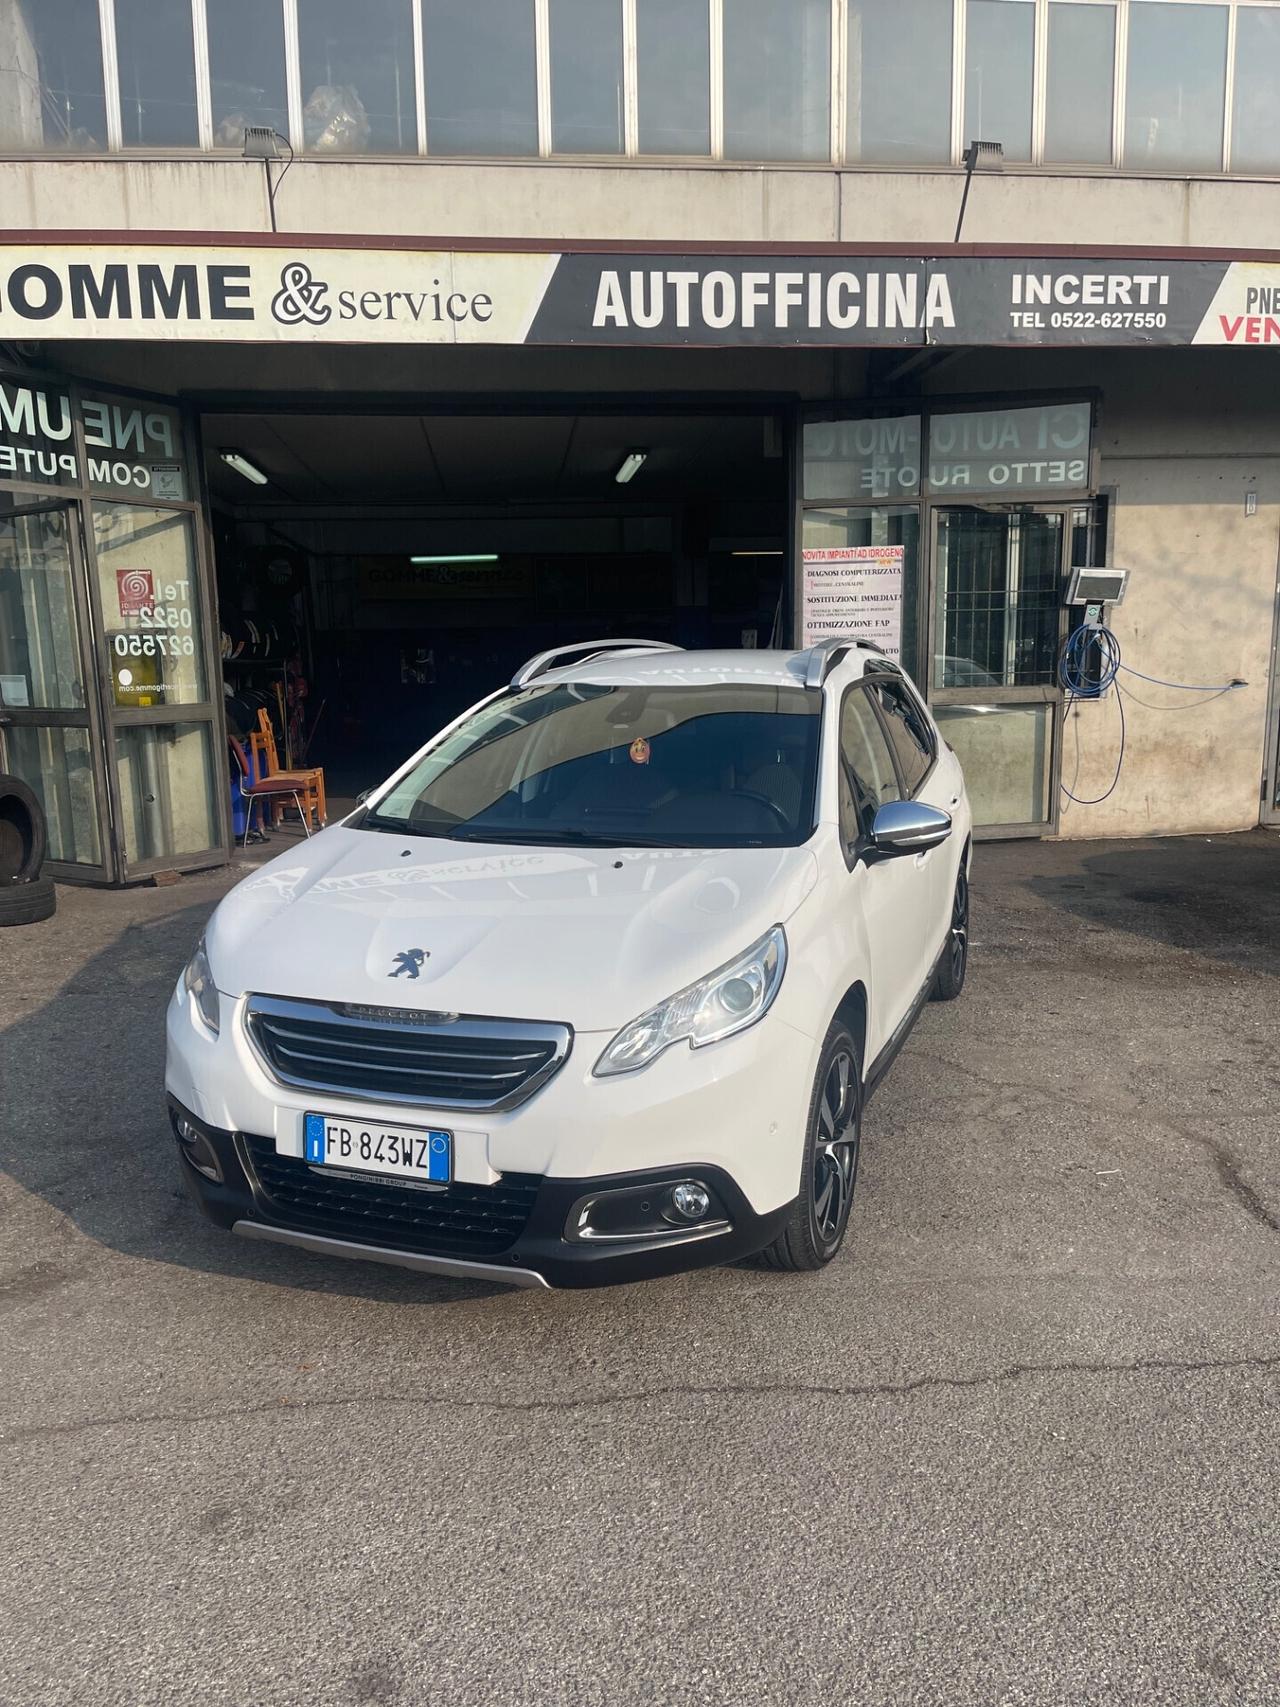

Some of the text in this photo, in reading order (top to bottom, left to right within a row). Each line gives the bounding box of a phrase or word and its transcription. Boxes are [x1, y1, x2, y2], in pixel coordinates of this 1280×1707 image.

[0, 264, 256, 321] OMME
[338, 278, 493, 322] service
[1011, 274, 1169, 306] INCERTI
[592, 270, 956, 329] AUTOFFICINA
[1009, 311, 1167, 329] TEL 0522-627550
[827, 549, 857, 560] IMPIANTI
[858, 549, 867, 559] AD
[840, 568, 901, 576] COMPUTERIZZATA
[807, 595, 857, 604] SOSTITUZIONE
[807, 620, 872, 629] OTTIMIZZAZIONE
[327, 1126, 428, 1169] FB 843WZ
